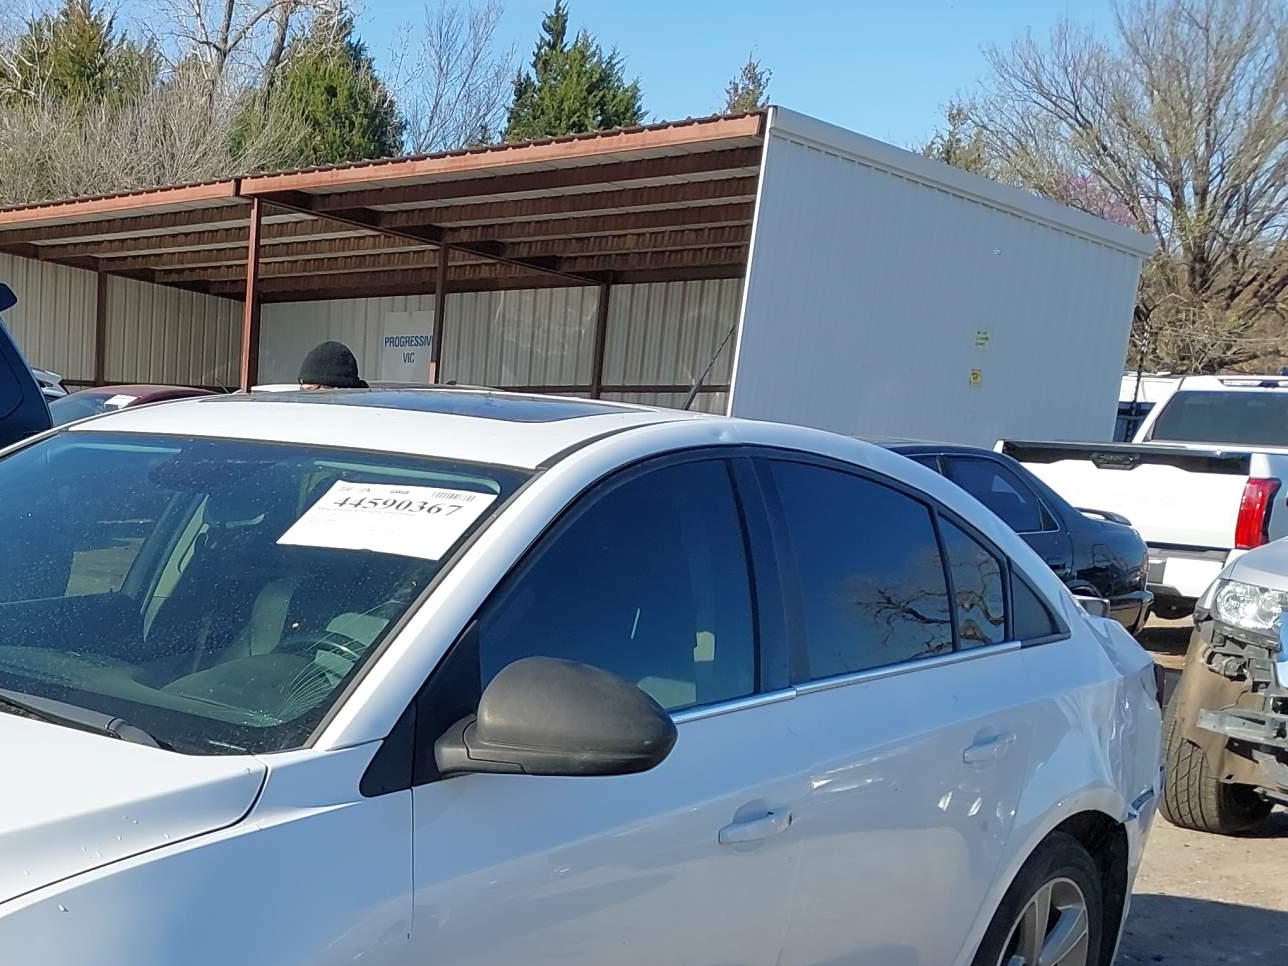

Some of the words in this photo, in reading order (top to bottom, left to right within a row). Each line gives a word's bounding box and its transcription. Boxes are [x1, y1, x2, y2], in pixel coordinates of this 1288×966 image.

[384, 336, 432, 348] PROGRESSIV
[403, 352, 415, 364] VIC
[333, 496, 465, 517] 44590367
